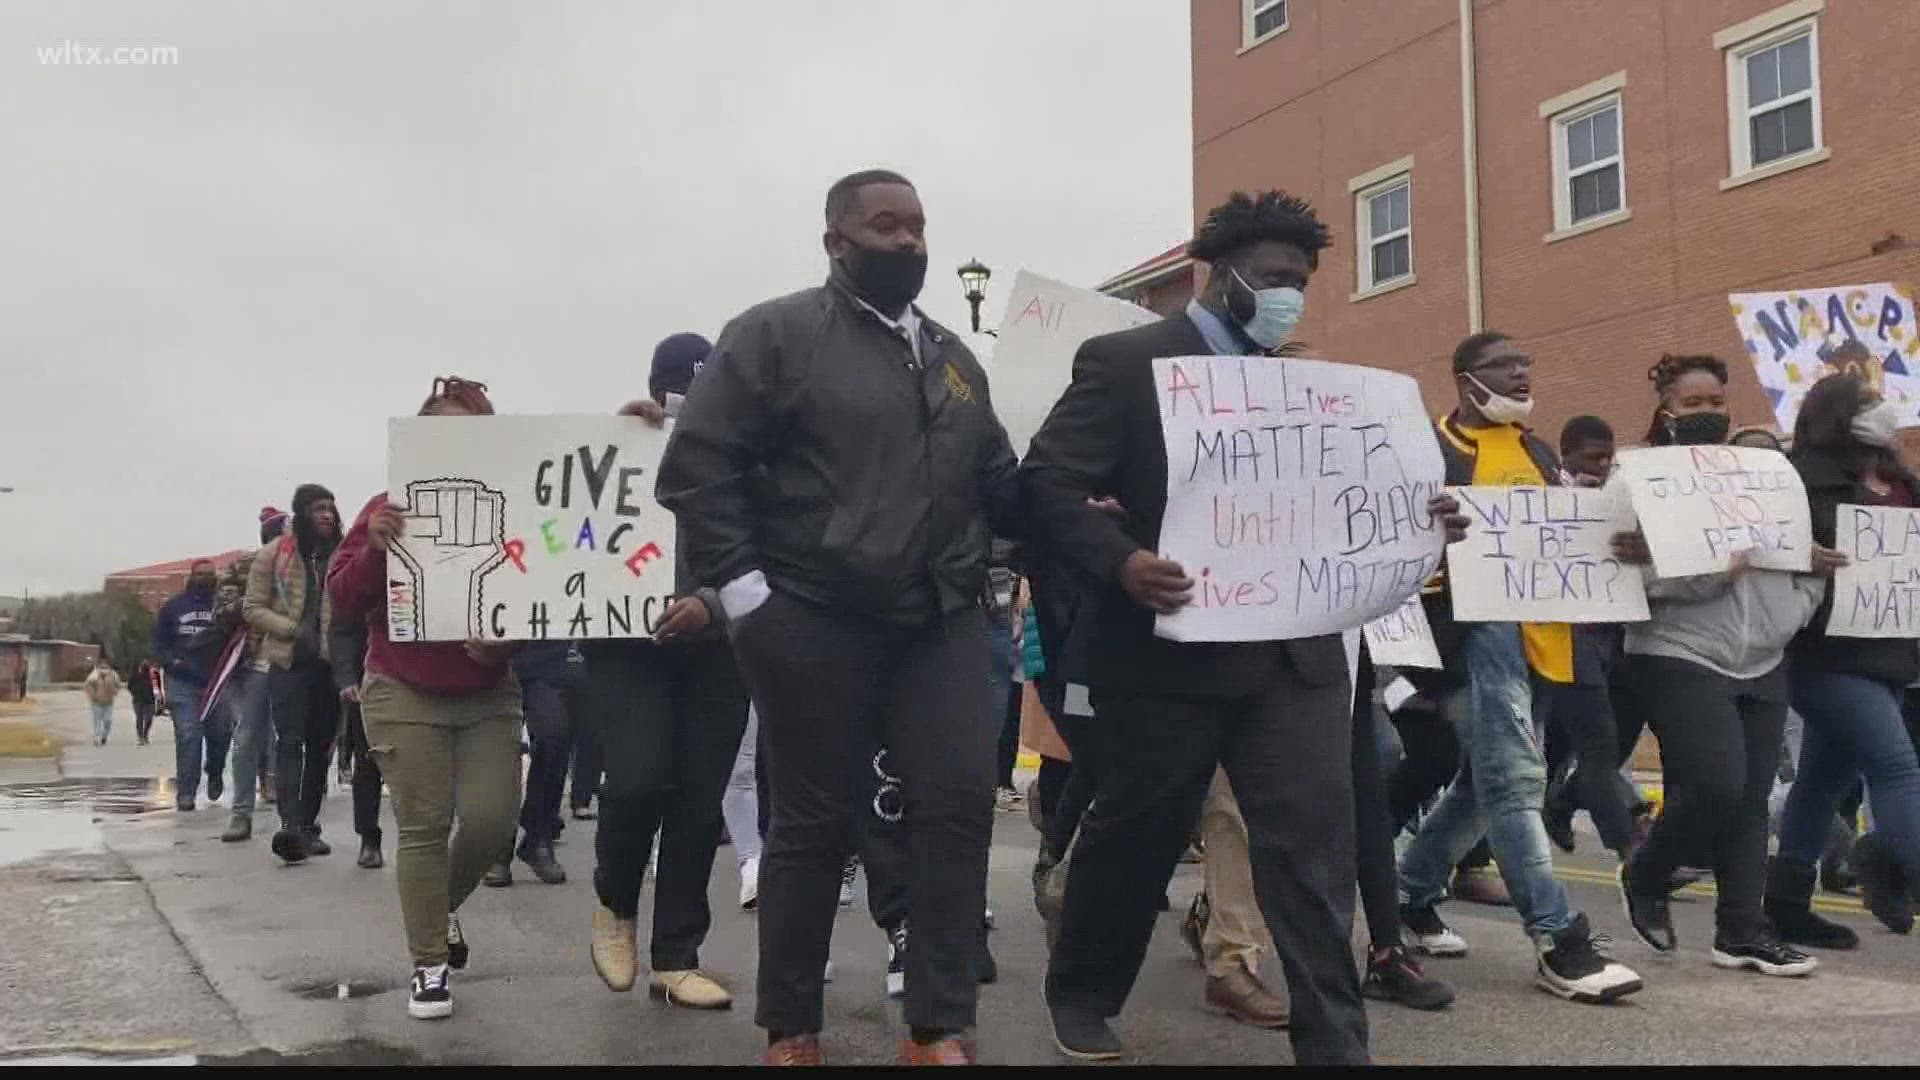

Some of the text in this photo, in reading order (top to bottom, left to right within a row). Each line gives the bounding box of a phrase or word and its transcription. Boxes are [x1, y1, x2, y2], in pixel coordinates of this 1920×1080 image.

[1168, 360, 1356, 416] ALL Lives
[1189, 422, 1408, 487] MATTER
[1690, 447, 1742, 474] NO
[535, 444, 643, 517] GIVE
[1646, 470, 1793, 499] JUSTICE
[1213, 485, 1317, 549] Until
[1458, 488, 1606, 527] WILL
[1710, 494, 1765, 529] NO
[503, 516, 664, 578] PEACE
[1480, 525, 1591, 560] I BE
[1703, 519, 1795, 560] PEACE
[564, 572, 586, 598] a
[1186, 562, 1279, 609] ives
[1503, 557, 1620, 603] NEXT?
[491, 594, 676, 639] CHANC
